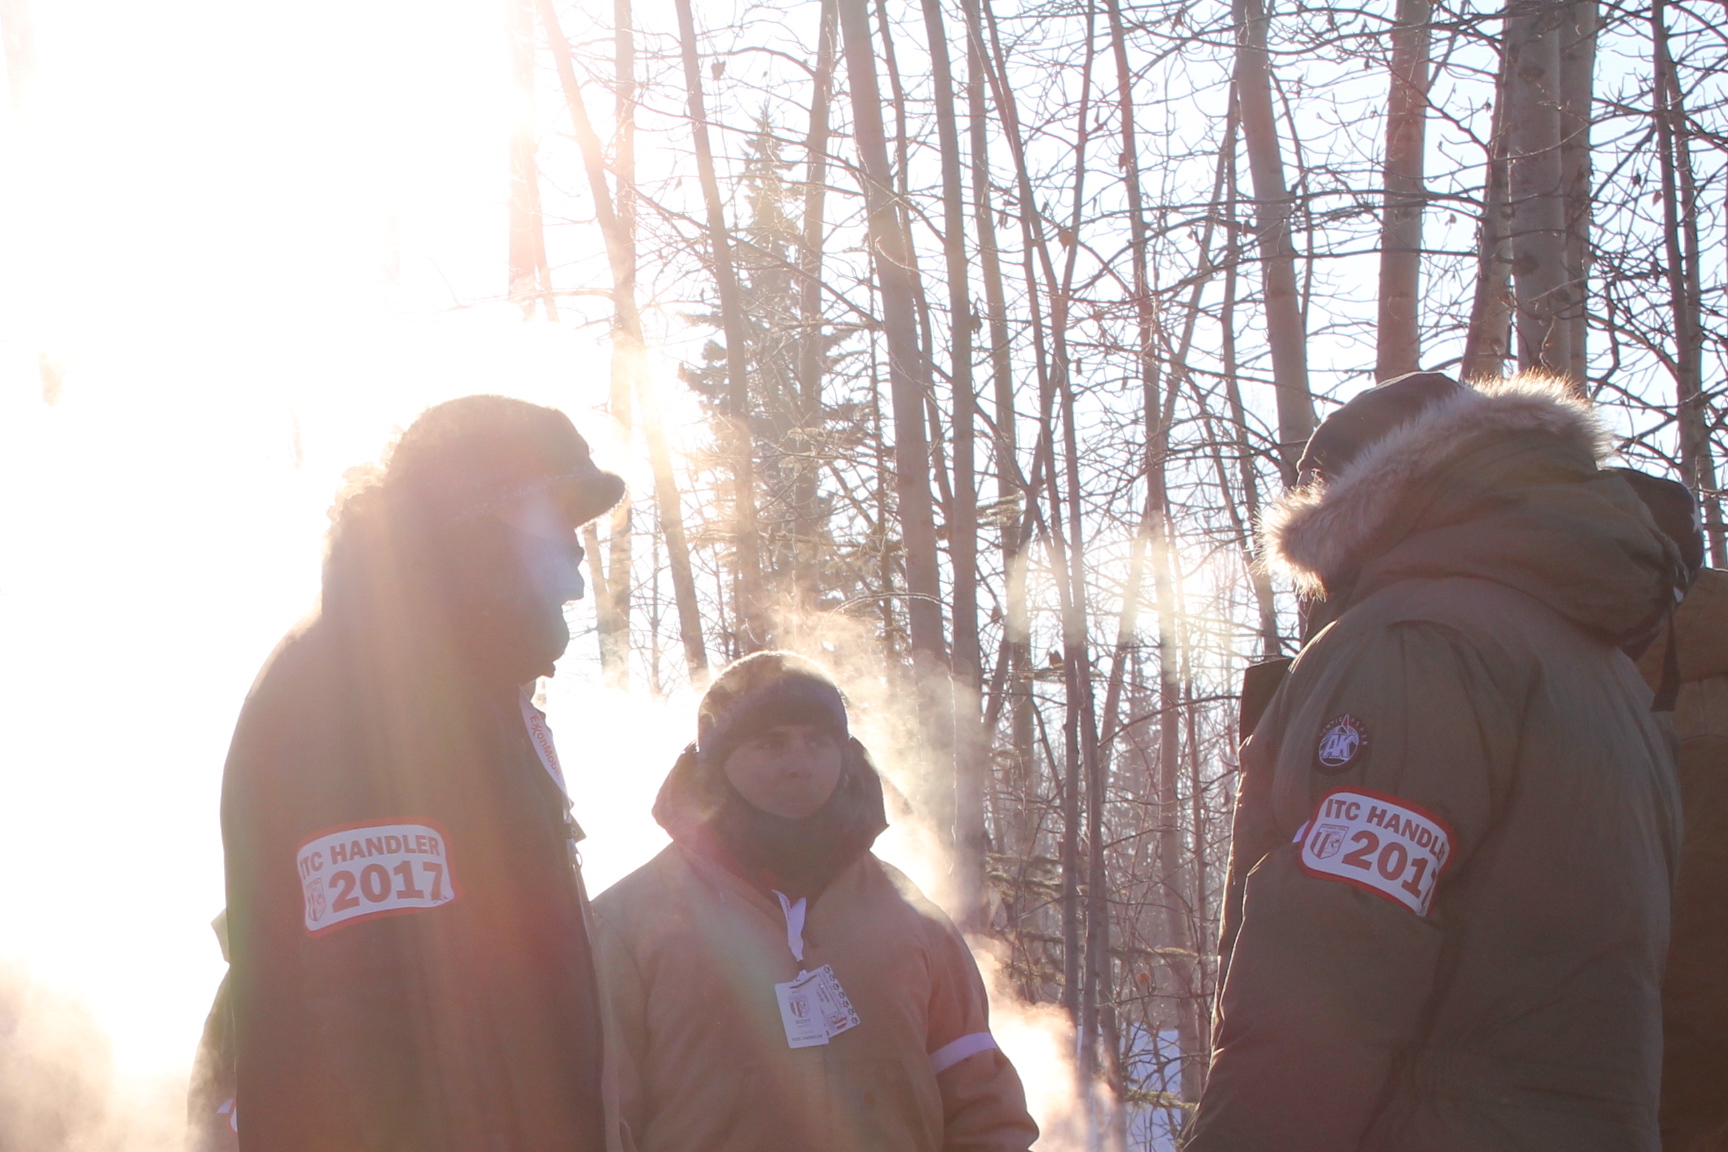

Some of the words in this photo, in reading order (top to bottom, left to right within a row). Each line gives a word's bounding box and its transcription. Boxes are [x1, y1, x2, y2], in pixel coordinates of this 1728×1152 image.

[530, 715, 561, 776] ExxonMobil
[1322, 734, 1355, 758] AK
[299, 852, 323, 880] ITC
[329, 834, 440, 865] HANDLER
[1325, 798, 1361, 821] ITC
[1366, 805, 1445, 862] HANDLE
[328, 860, 443, 914] 2017
